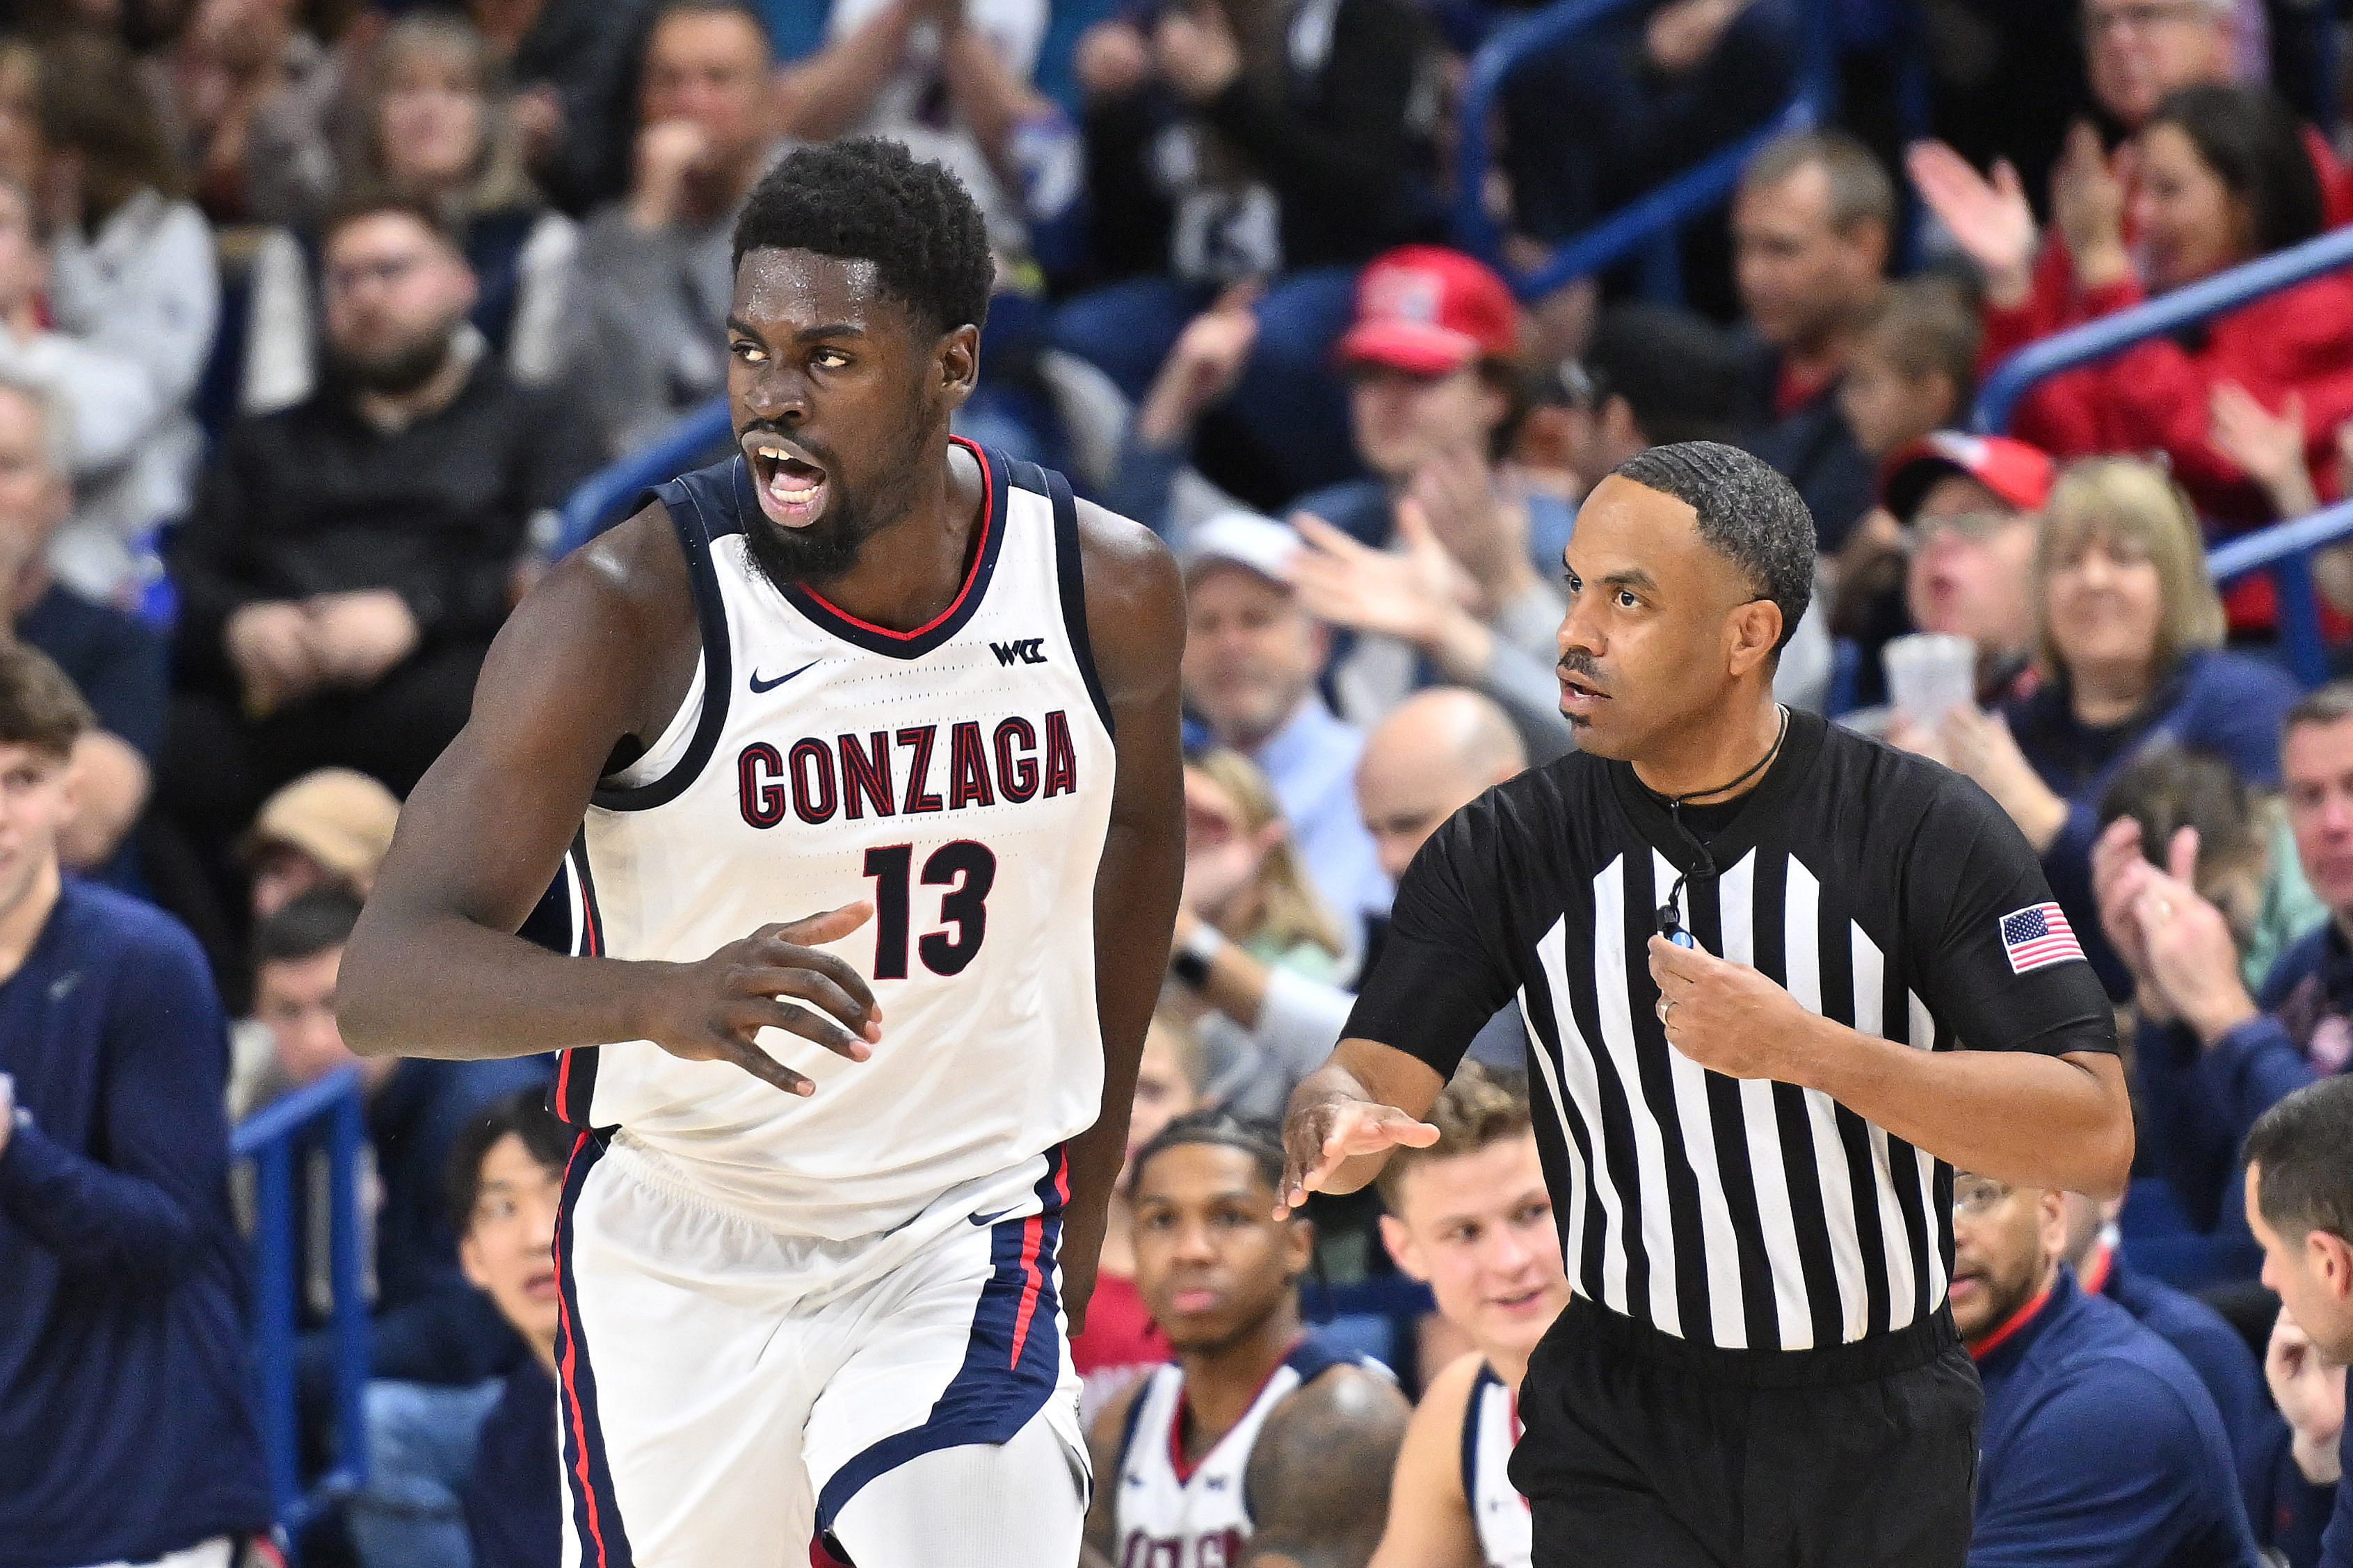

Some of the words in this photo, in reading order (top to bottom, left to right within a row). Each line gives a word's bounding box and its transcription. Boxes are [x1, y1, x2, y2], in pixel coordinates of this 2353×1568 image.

[989, 638, 1048, 668] WCC
[737, 710, 1077, 829] GONZAGA
[862, 839, 997, 980] 13
